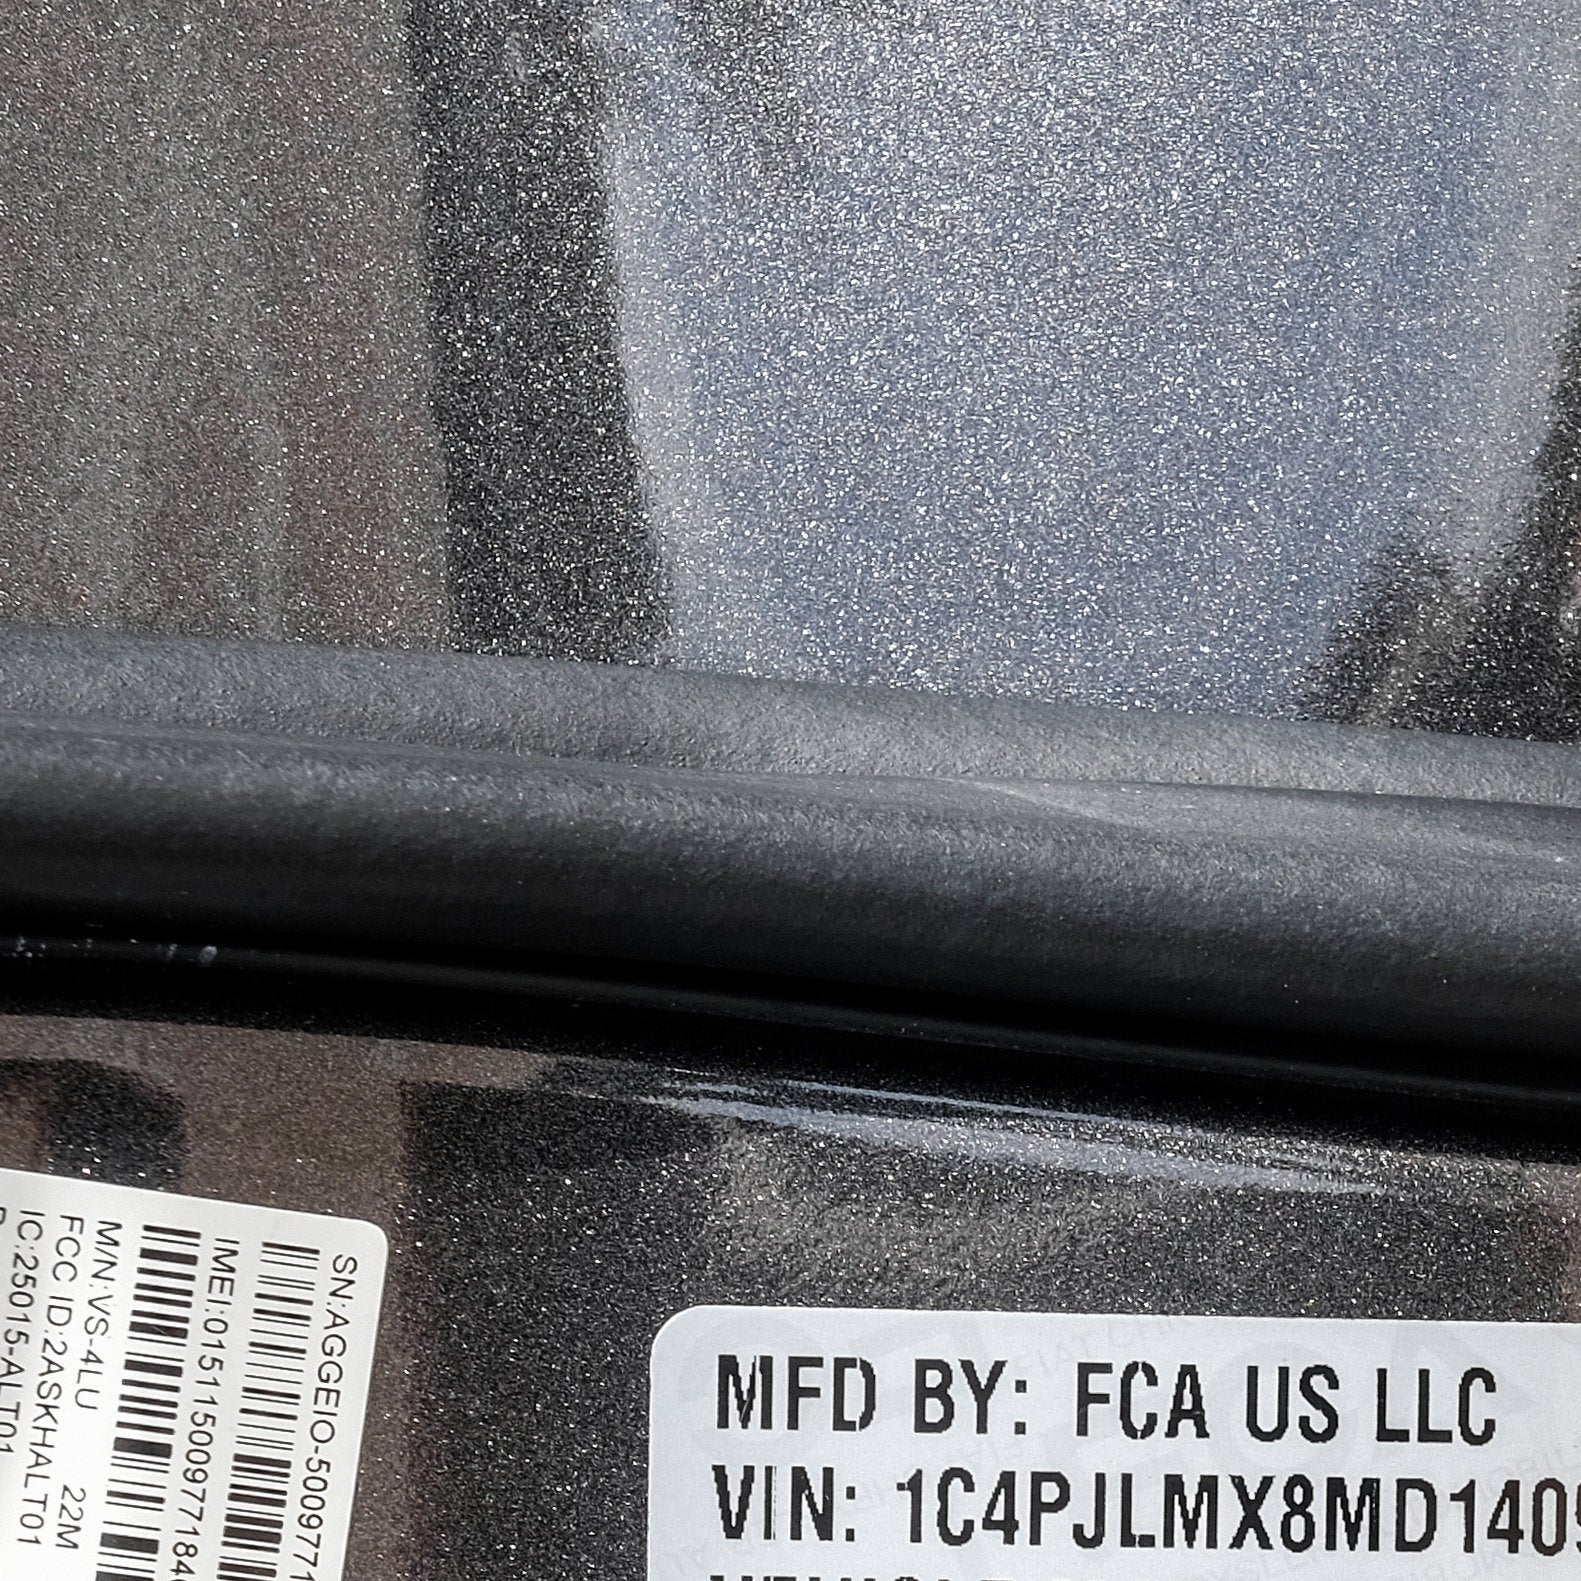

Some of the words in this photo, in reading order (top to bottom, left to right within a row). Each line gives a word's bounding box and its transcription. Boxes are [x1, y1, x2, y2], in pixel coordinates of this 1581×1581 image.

[53, 1213, 83, 1284] FCC
[75, 1219, 122, 1411] M/N:VS-4LU
[18, 1295, 72, 1546] ID:2ASKHALT01
[717, 1355, 876, 1431] MFD
[914, 1359, 1026, 1435] BY:
[1077, 1361, 1209, 1439] FCA
[1246, 1365, 1339, 1443] US
[1376, 1368, 1496, 1446] LLC
[55, 1485, 86, 1551] 22M
[712, 1465, 855, 1541] VIN:
